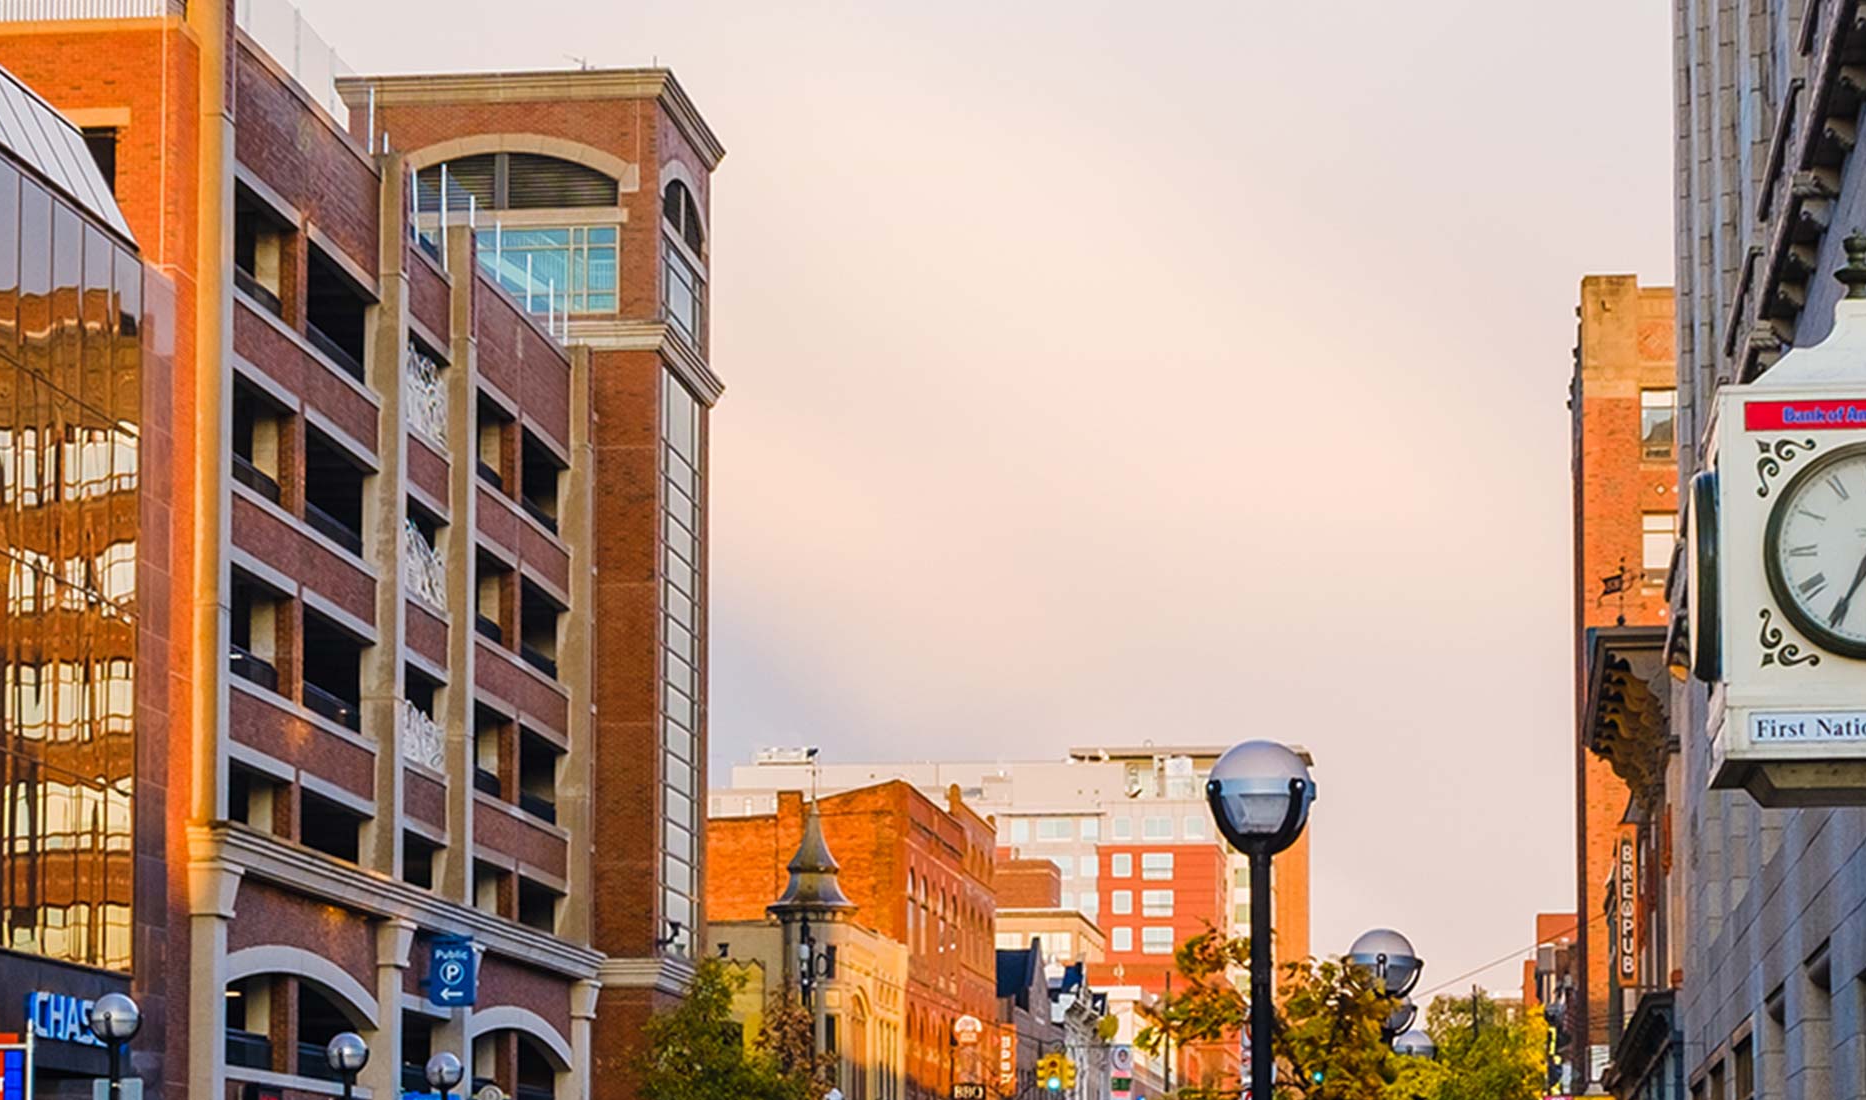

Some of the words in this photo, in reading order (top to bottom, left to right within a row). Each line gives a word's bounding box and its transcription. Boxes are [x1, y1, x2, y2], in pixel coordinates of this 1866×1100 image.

[1783, 405, 1825, 423] Bank
[1826, 405, 1845, 422] of
[1757, 718, 1806, 738] First
[32, 989, 112, 1047] CHAS
[953, 1085, 985, 1100] BBQ
